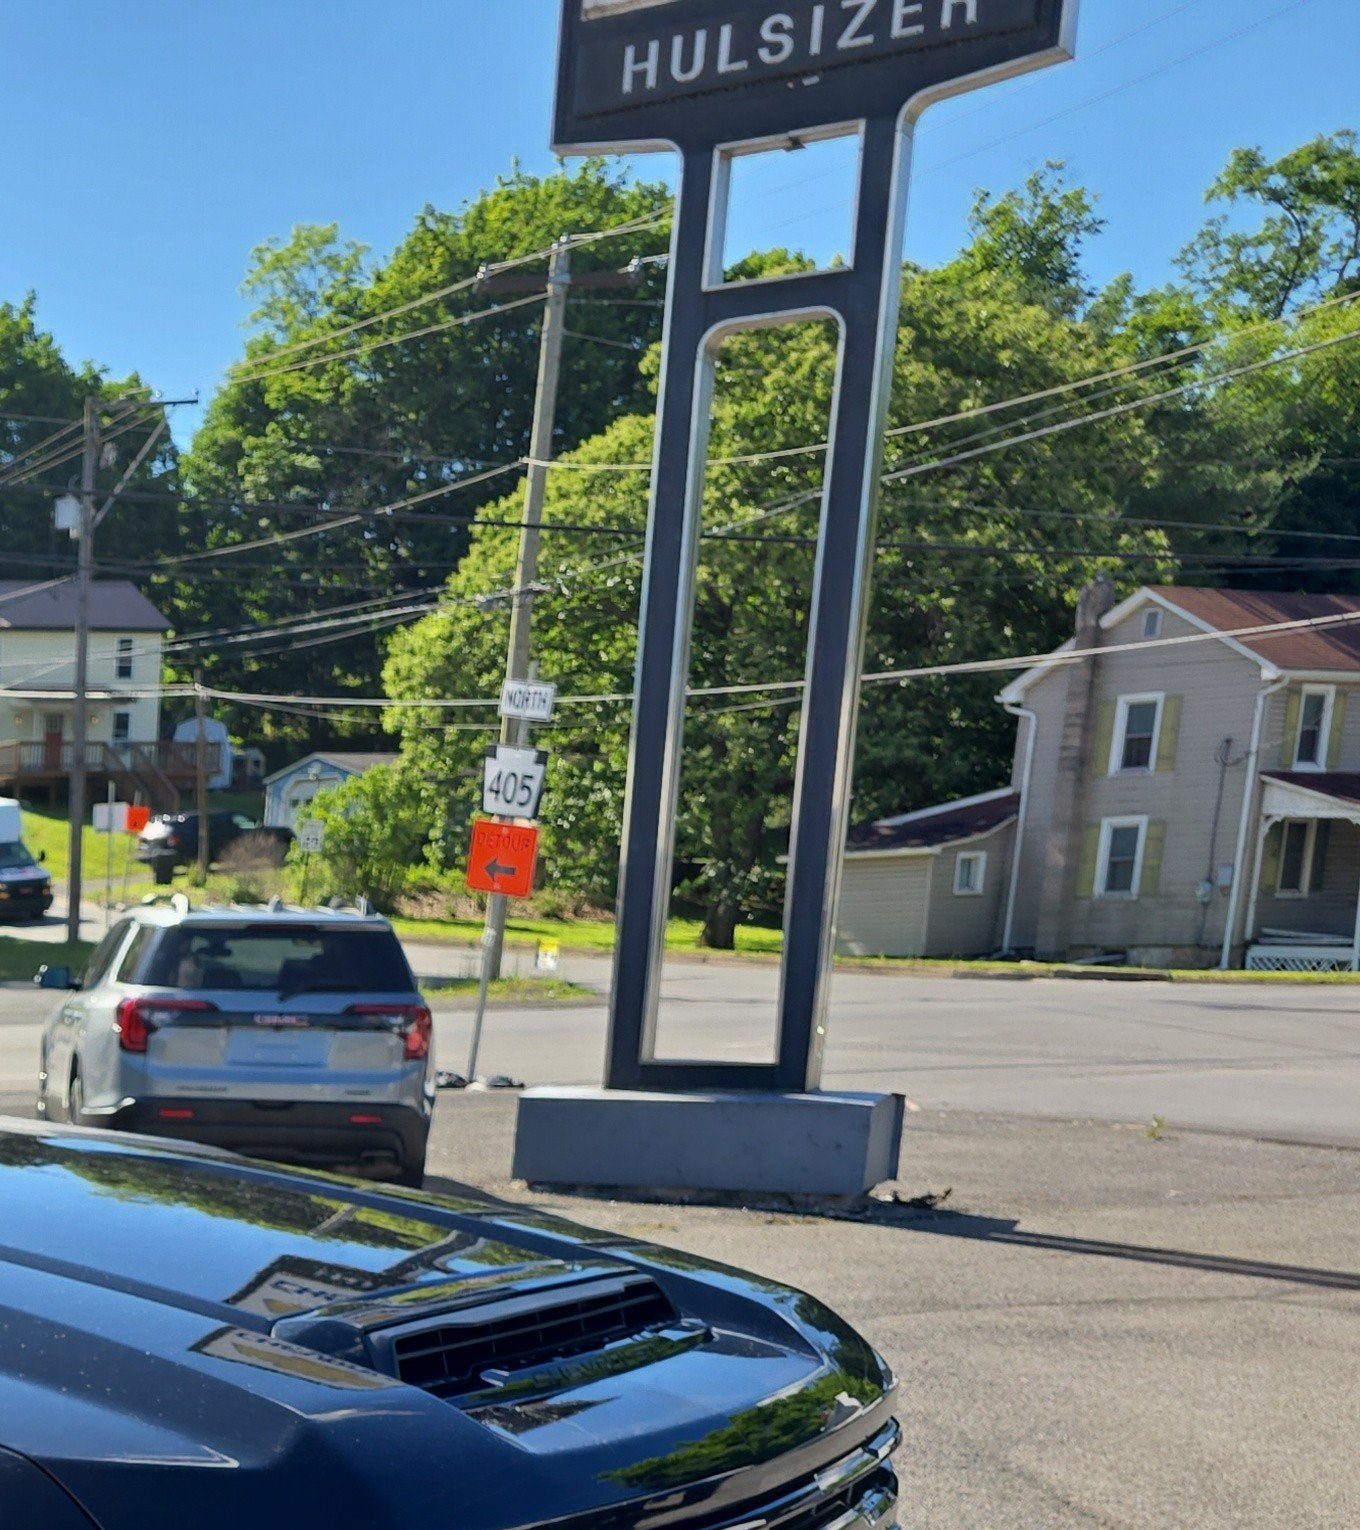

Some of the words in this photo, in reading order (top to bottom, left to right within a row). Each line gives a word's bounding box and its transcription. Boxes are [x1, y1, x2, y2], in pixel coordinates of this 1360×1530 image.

[505, 688, 548, 713] NORTH
[488, 770, 534, 807] 405
[478, 830, 531, 851] DETOUR
